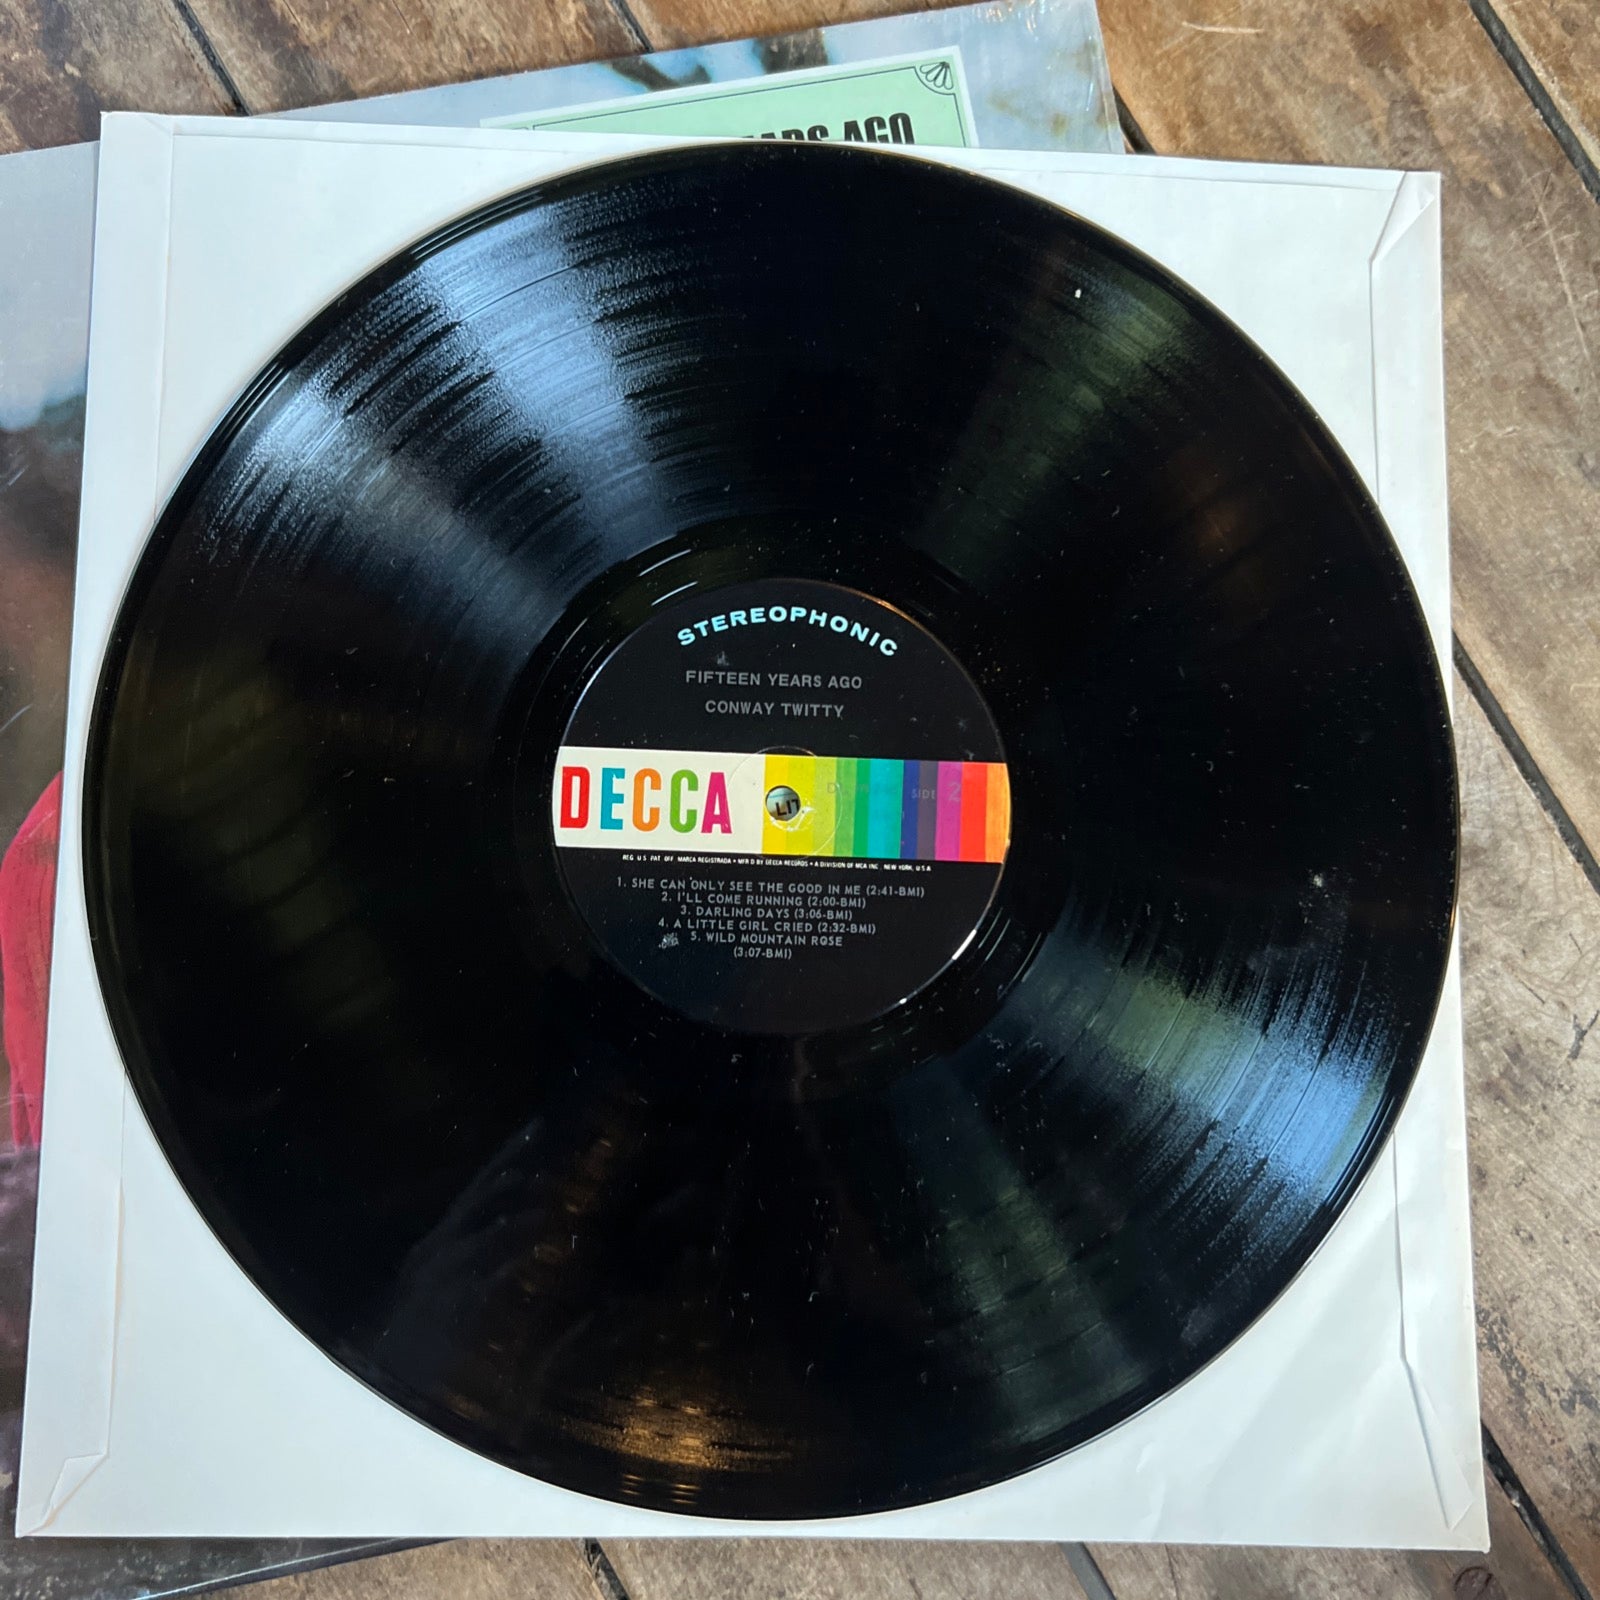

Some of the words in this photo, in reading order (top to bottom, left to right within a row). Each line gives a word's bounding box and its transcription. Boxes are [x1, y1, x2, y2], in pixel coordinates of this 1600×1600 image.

[843, 112, 915, 145] AGO
[677, 605, 899, 657] STEREOPHONIC
[686, 670, 761, 686] FIFTEEN
[768, 672, 822, 688] YEARS
[828, 674, 863, 689] AGO
[705, 700, 775, 715] CONWAY
[780, 702, 845, 718] TWITTY
[560, 766, 732, 834] DECCA
[911, 788, 936, 799] SIDE
[948, 782, 961, 802] 2
[698, 856, 732, 864] REGISTRADA
[784, 859, 809, 867] RECORDS
[617, 876, 627, 888] 1.
[631, 877, 655, 889] SHE
[660, 879, 686, 890] CAN
[691, 880, 725, 891] ONLY
[729, 881, 753, 892] SEE
[758, 881, 784, 893] THE
[788, 882, 823, 894] GOOD
[828, 884, 840, 895] IN
[844, 884, 861, 896] ME
[866, 885, 925, 898] (2:41-BMI)
[661, 892, 672, 902] 2.
[677, 892, 703, 903] I'LL
[707, 893, 742, 905] COME
[746, 894, 803, 906] RUNNING
[807, 896, 867, 909] (2:00-BMI)
[680, 904, 691, 915] 3.
[696, 906, 752, 918] DARLING
[757, 907, 790, 919] DAYS
[794, 908, 853, 921] (3:06-BMI)
[658, 919, 669, 929] 4.
[673, 920, 682, 929] A
[687, 919, 734, 930] LITTLE
[739, 921, 769, 931] GIRL
[774, 922, 813, 933] CRIED
[817, 922, 876, 935] (2:32-BMI)
[690, 931, 701, 942] 5.
[706, 932, 736, 943] WILD
[740, 933, 806, 945] MOUNTAIN
[811, 935, 843, 947] ROSE
[733, 946, 793, 960] (3:07-BMI)
